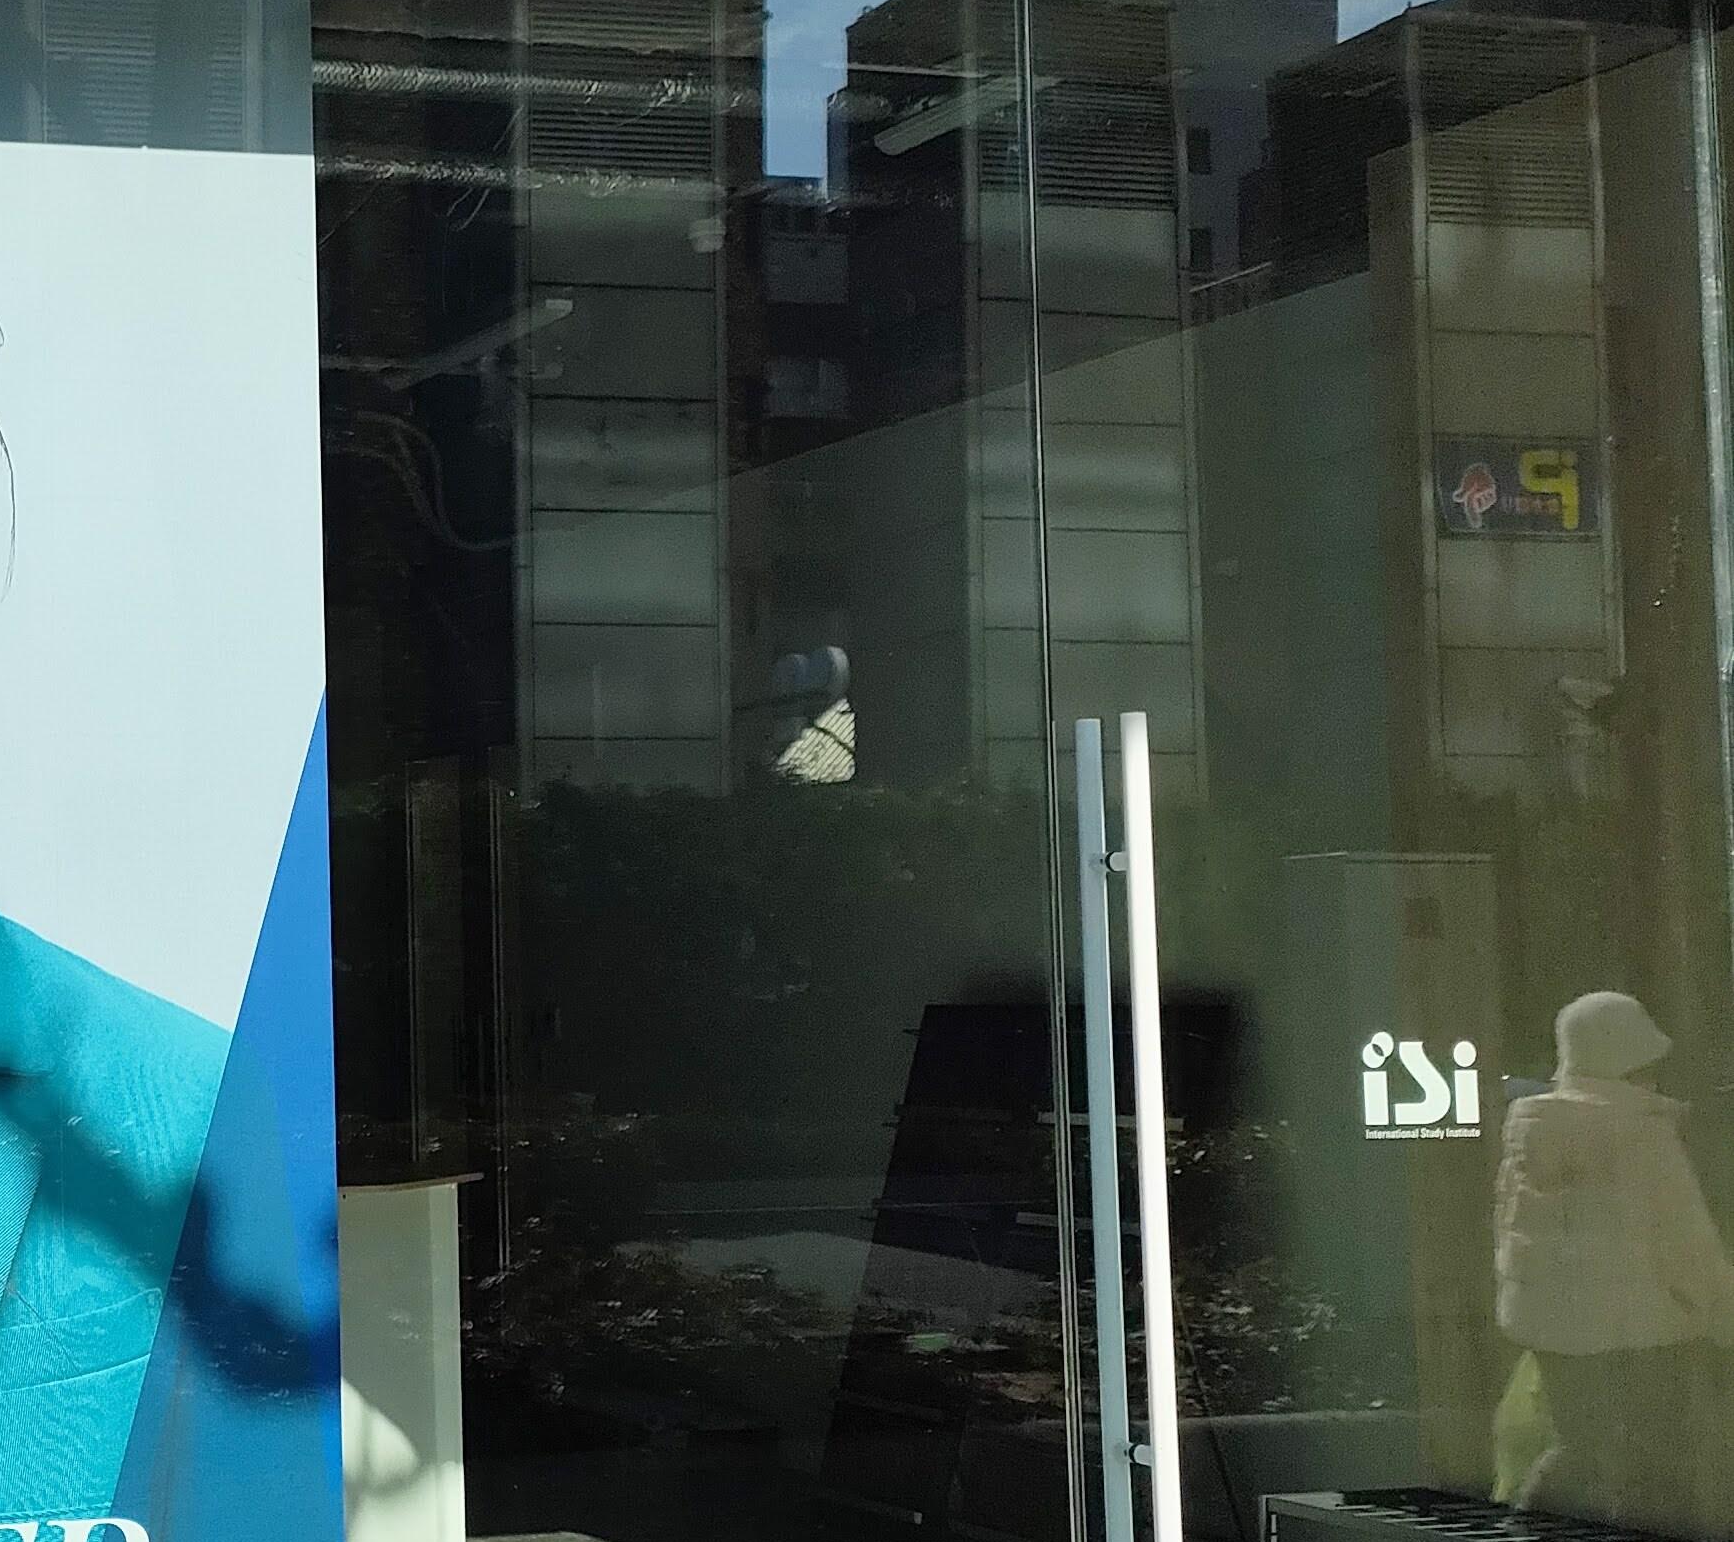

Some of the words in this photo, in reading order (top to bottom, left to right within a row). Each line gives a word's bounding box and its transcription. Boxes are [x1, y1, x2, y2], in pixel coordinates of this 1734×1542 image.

[1366, 1128, 1419, 1139] International
[1420, 1128, 1445, 1139] Study
[1446, 1127, 1481, 1138] Institute
